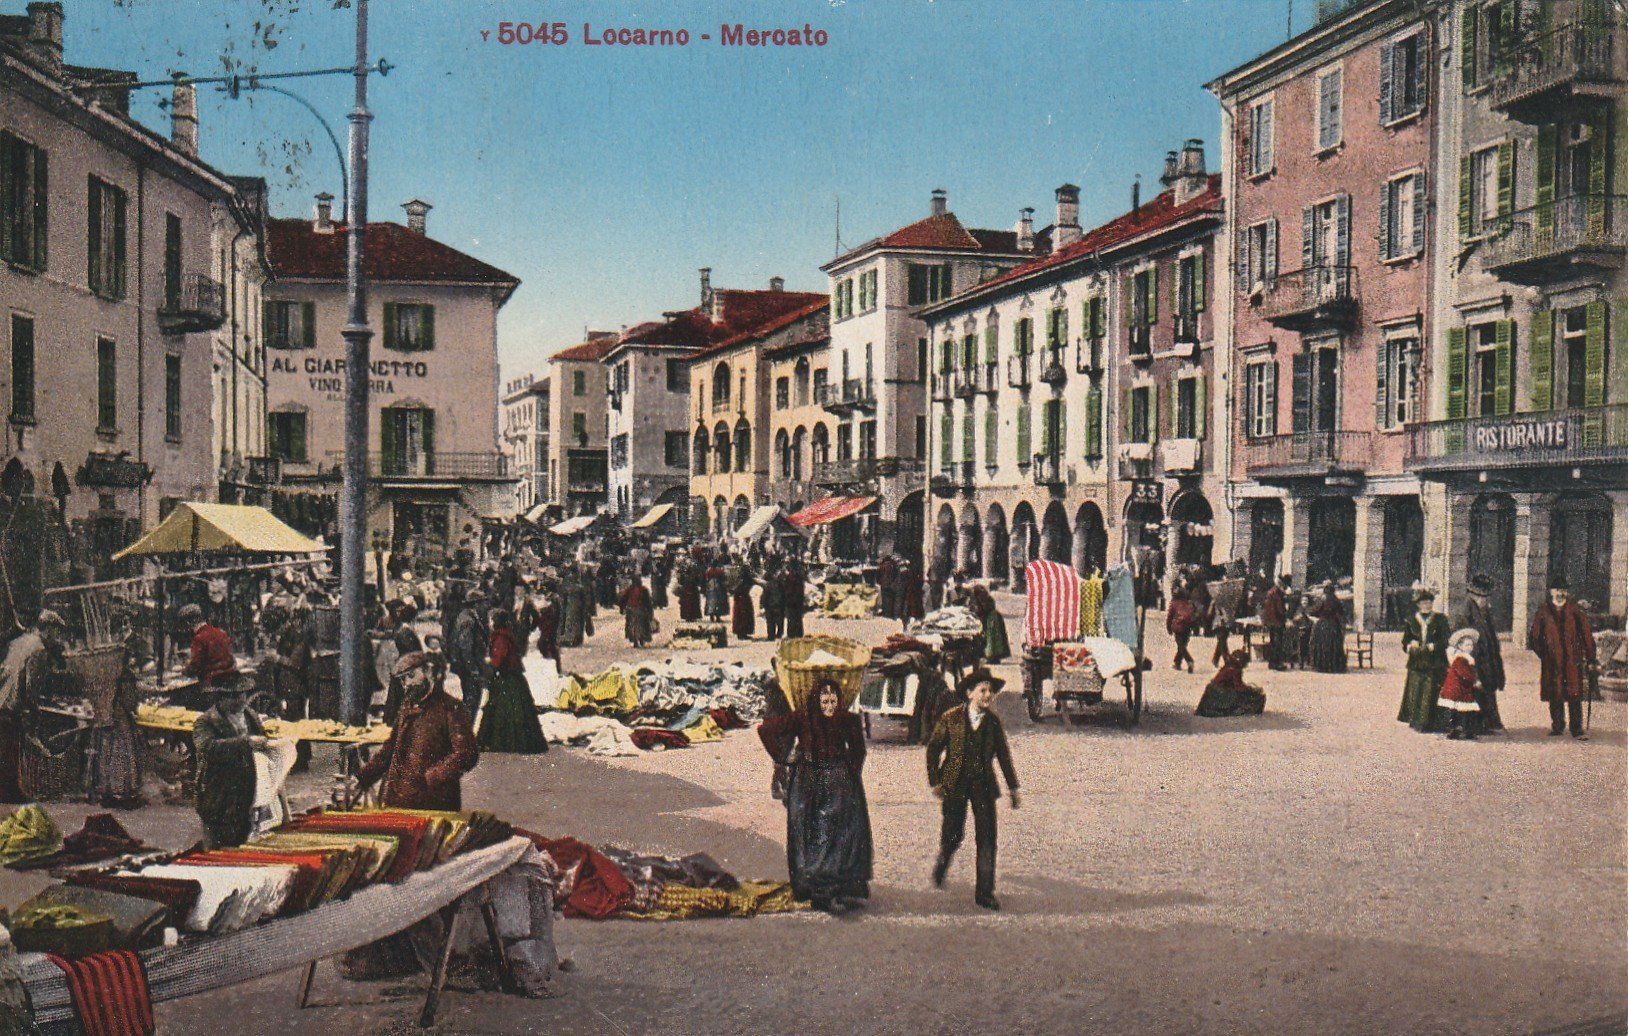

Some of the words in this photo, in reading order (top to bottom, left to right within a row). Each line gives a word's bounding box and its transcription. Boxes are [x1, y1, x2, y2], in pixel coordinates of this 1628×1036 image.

[272, 357, 297, 373] AL
[304, 358, 428, 376] GIARNETTO
[1476, 420, 1566, 450] RISTORANTE
